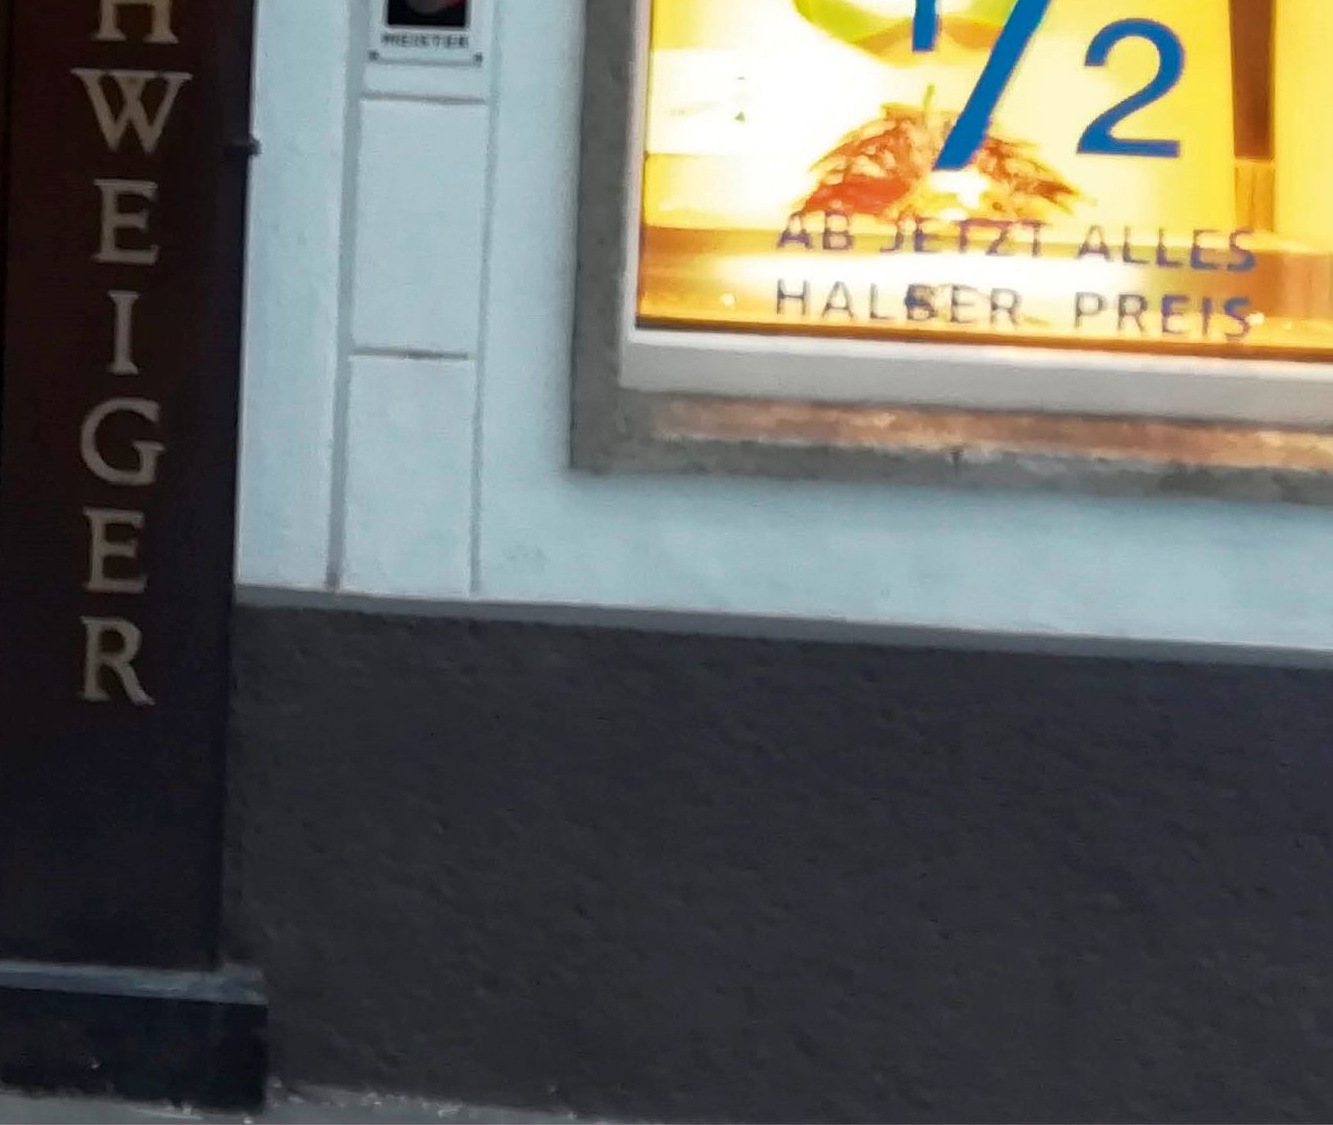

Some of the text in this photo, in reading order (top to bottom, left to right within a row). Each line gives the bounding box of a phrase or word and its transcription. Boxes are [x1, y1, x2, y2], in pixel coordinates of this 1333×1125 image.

[776, 211, 1257, 272] AB JETZT ALLES
[776, 279, 1253, 340] HALBER PREIS
